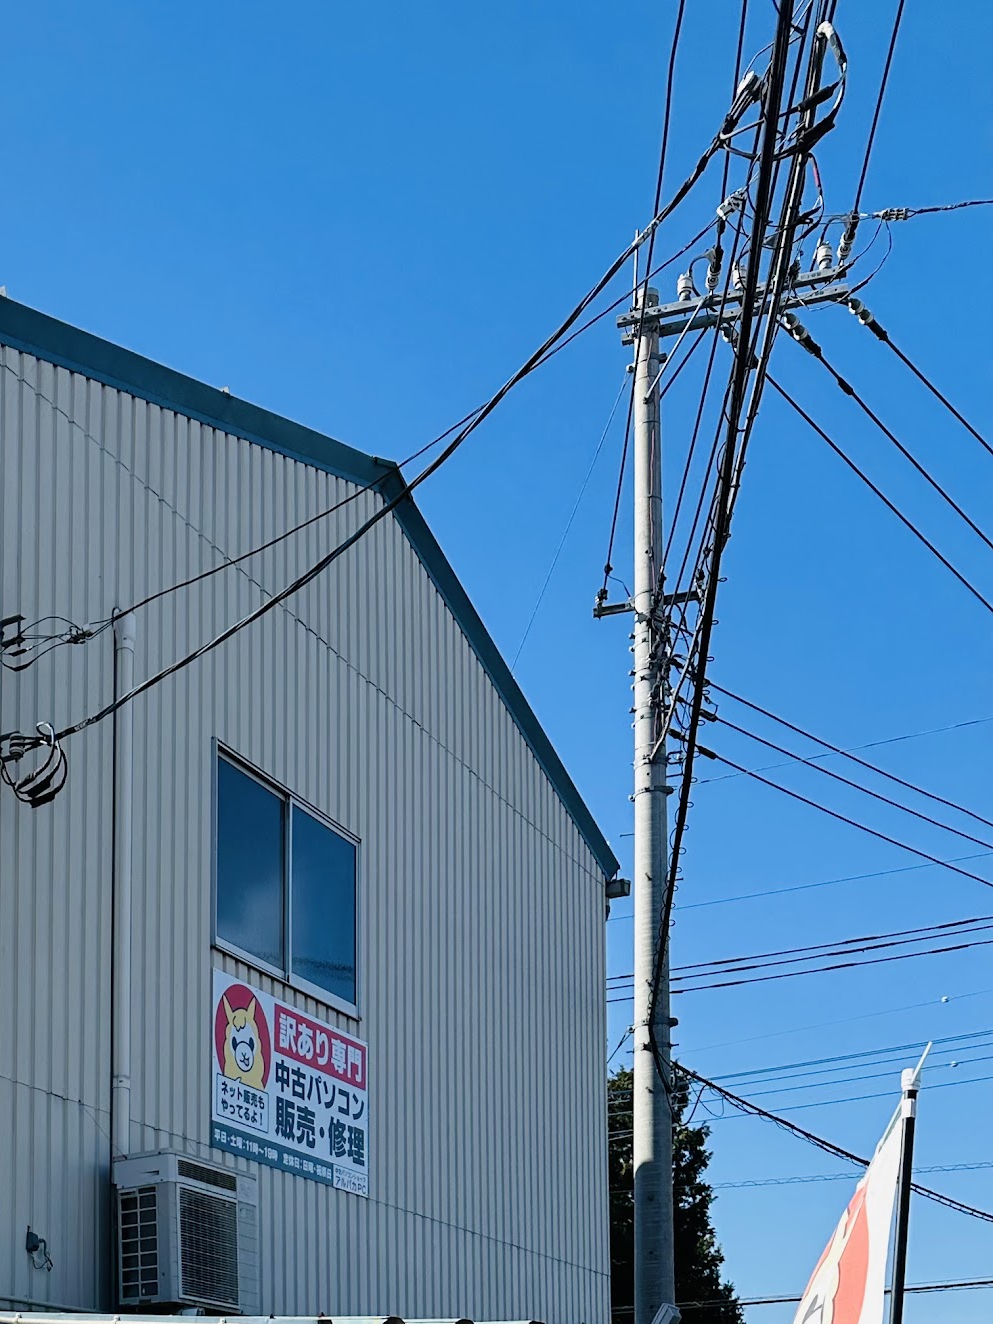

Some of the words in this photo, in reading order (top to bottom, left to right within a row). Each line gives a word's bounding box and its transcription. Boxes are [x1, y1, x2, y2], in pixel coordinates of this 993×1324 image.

[278, 1012, 363, 1083] 訳あり専門
[221, 1080, 265, 1110] ネット販売も
[221, 1097, 263, 1126] やってるよ！
[275, 1059, 365, 1120] 中古パソコン
[275, 1096, 365, 1167] 販売・修理
